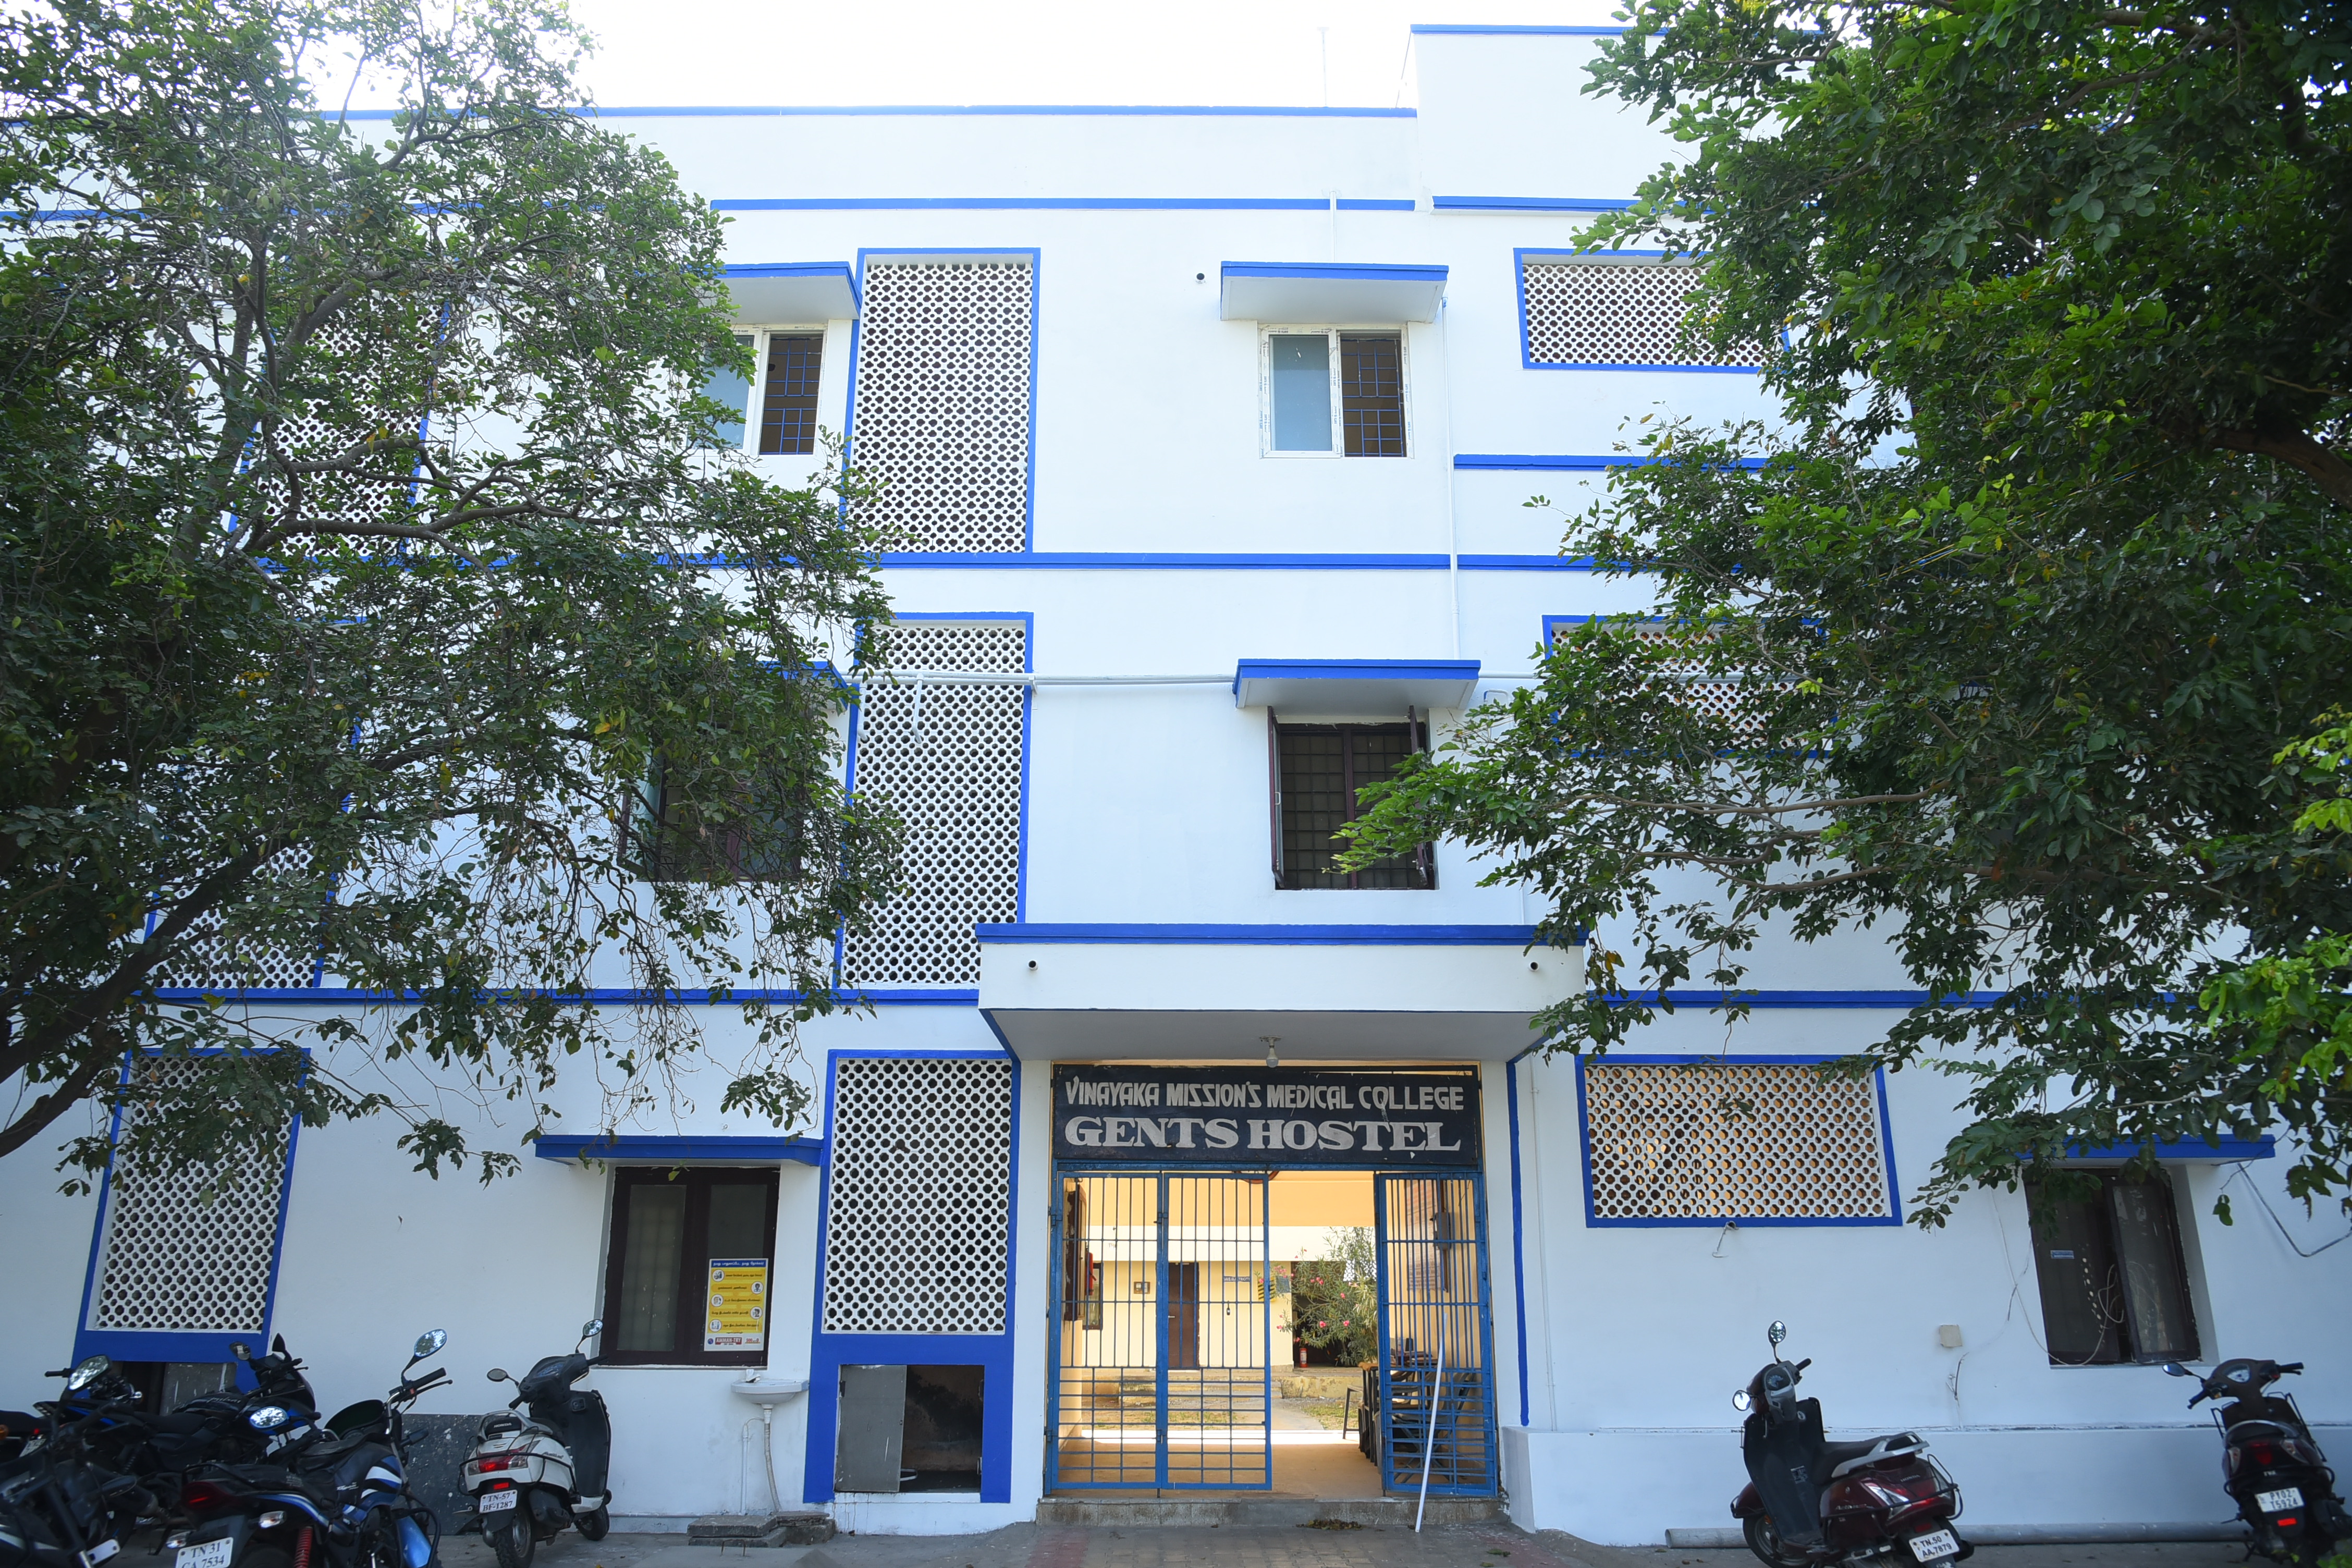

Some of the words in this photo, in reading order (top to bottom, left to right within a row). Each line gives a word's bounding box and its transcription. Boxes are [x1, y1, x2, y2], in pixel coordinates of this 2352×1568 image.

[1065, 1075, 1160, 1108] VINAYAKA
[1166, 1081, 1262, 1108] MISSION'S
[1267, 1084, 1354, 1110] MEDICAL
[1358, 1086, 1464, 1110] COLLEGE
[1065, 1116, 1239, 1148] GENTS
[1246, 1119, 1461, 1152] HOSTEL
[488, 1492, 511, 1502] TN-57
[2269, 1489, 2293, 1500] PY02
[483, 1501, 513, 1511] BF-1287
[2270, 1497, 2298, 1510] T5924
[191, 1545, 207, 1558] TN
[209, 1542, 221, 1554] 31
[201, 1554, 225, 1568] 7534
